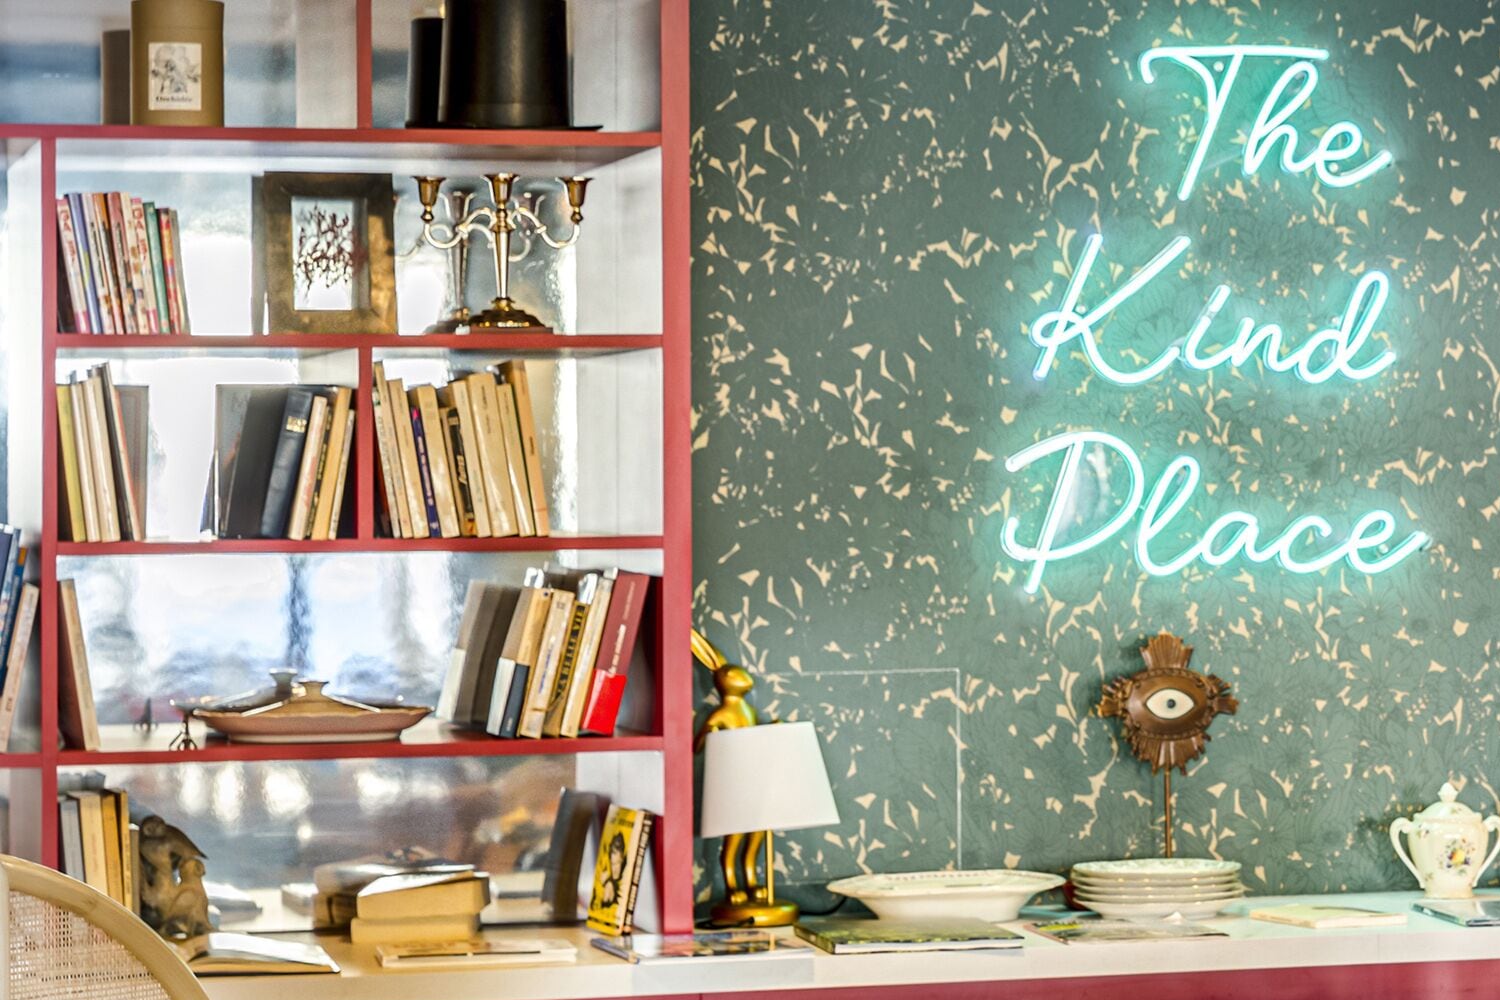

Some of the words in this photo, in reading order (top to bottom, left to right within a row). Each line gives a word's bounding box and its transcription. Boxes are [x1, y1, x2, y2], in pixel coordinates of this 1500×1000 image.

[1138, 44, 1393, 201] The
[1030, 233, 1397, 384] Kind
[1000, 431, 1432, 594] Place
